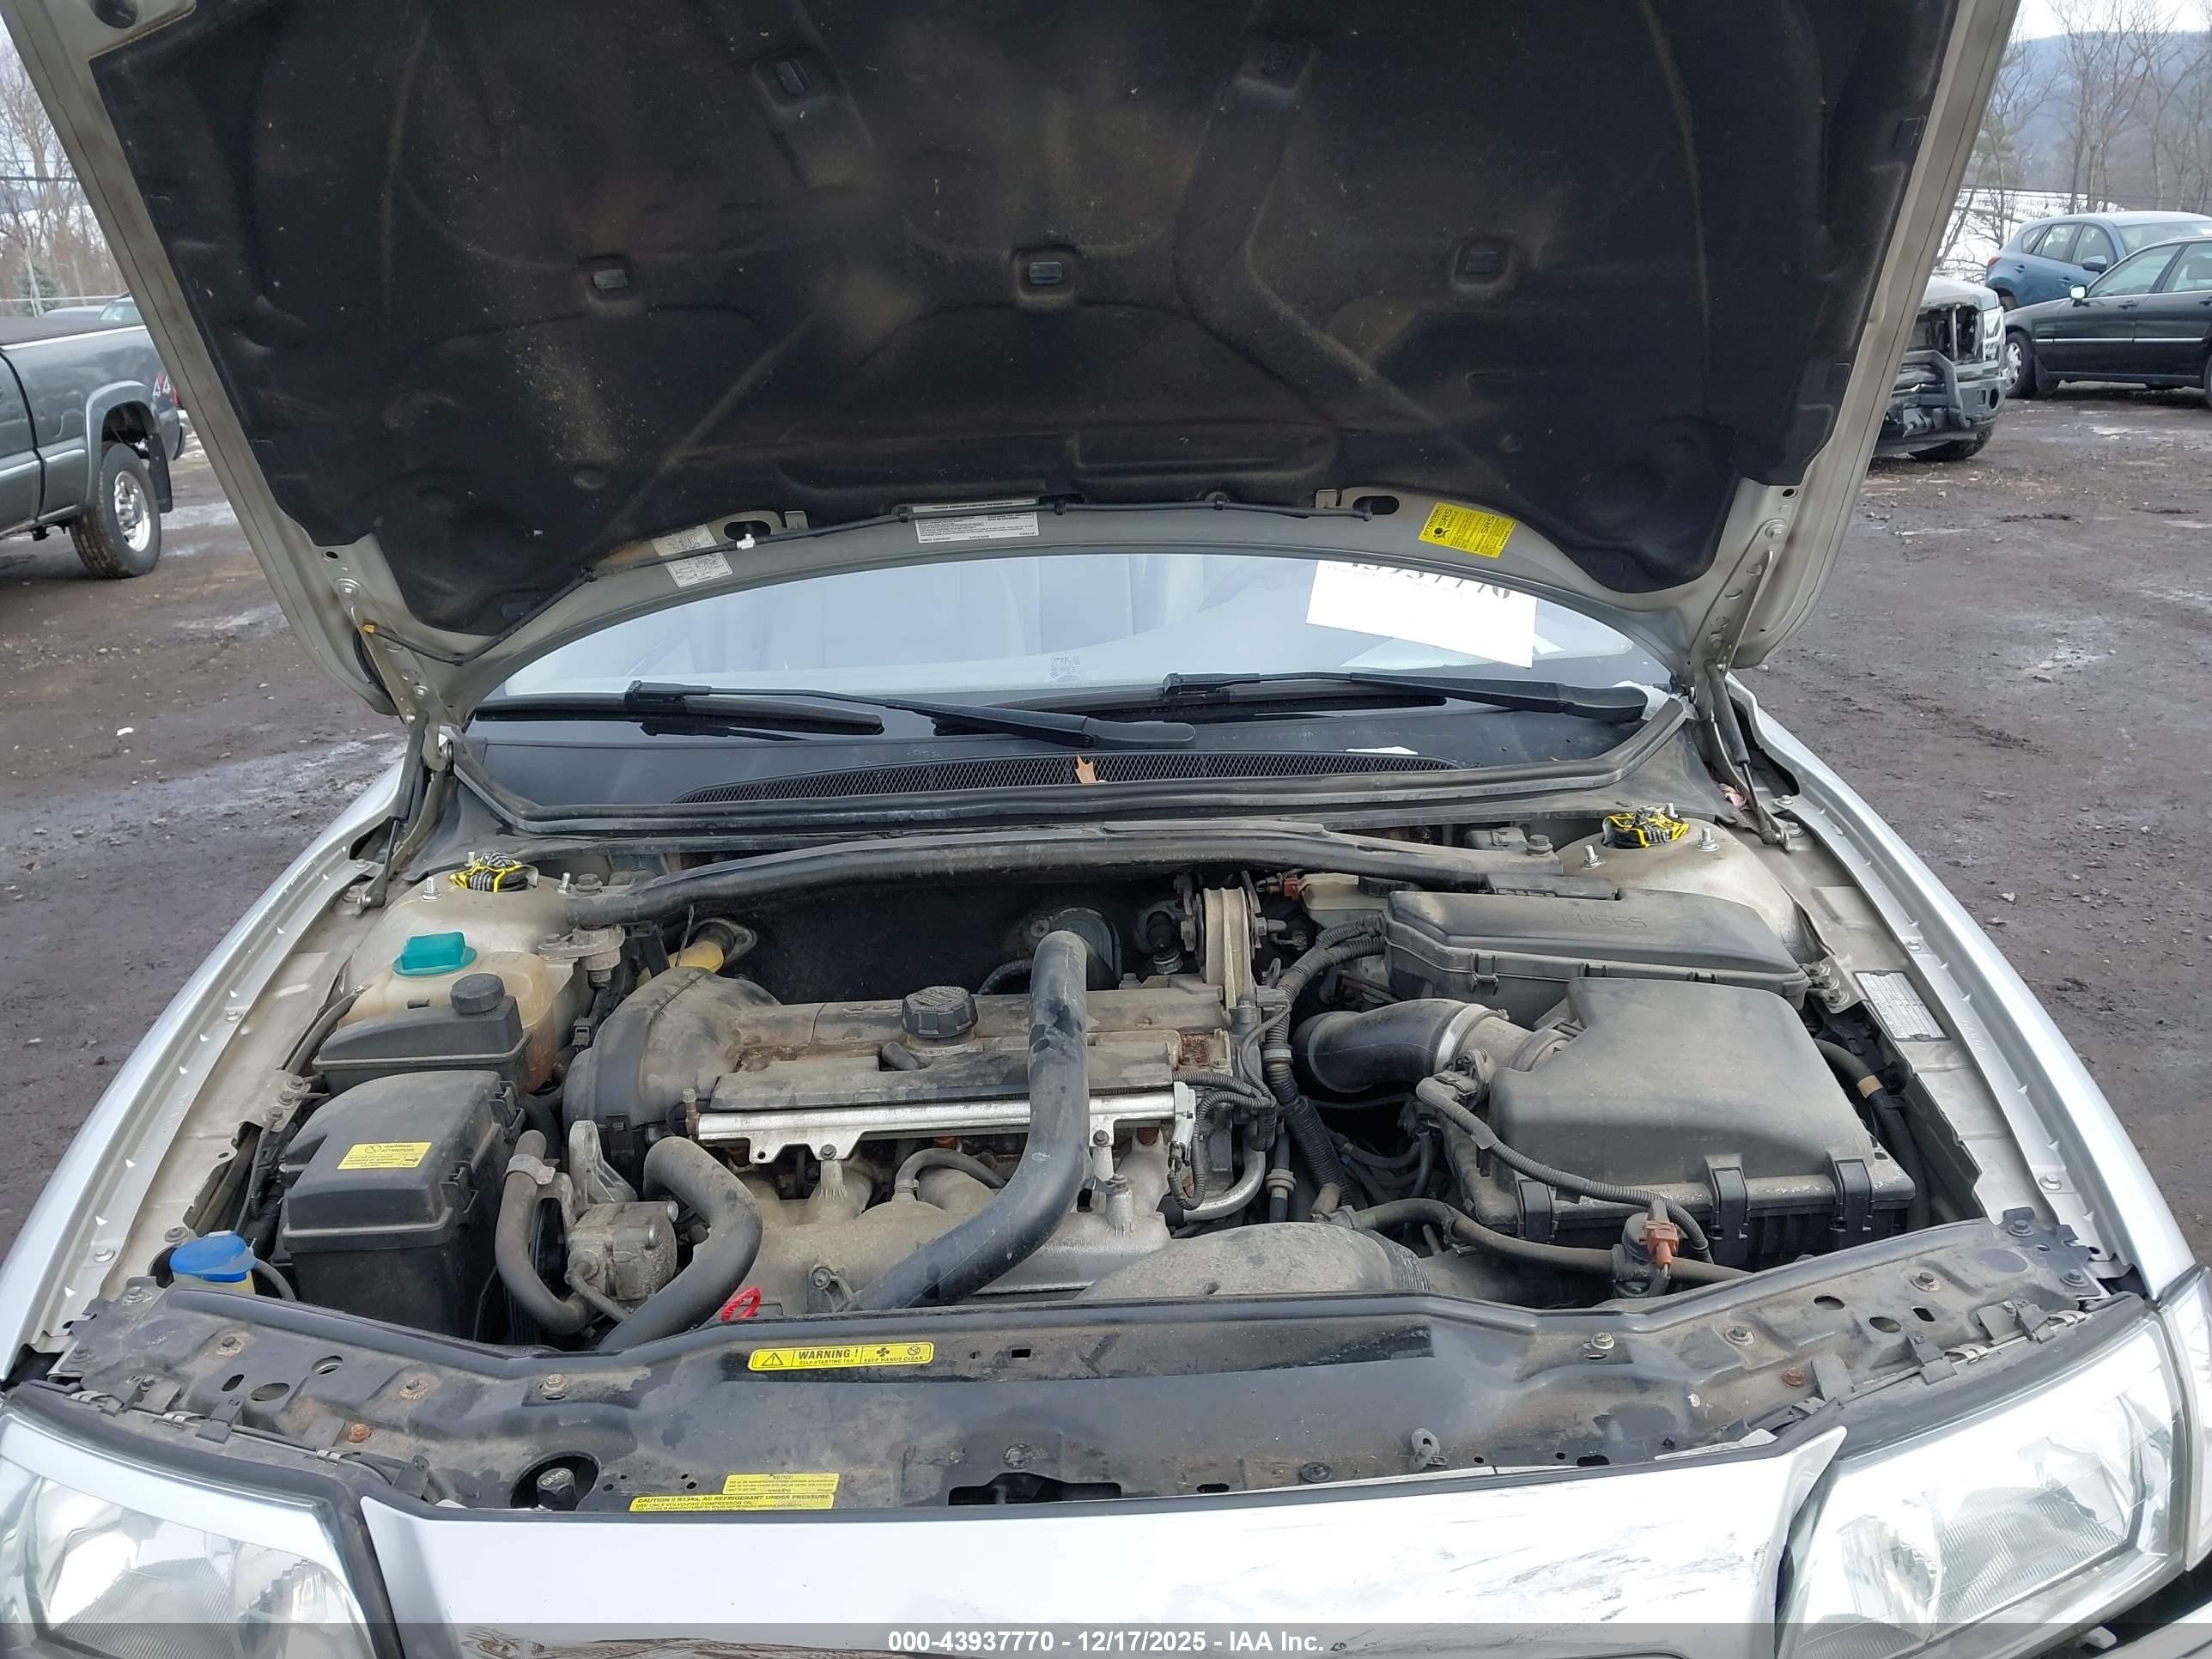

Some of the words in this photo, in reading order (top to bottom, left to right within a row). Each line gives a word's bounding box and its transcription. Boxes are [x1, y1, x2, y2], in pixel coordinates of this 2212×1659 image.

[1438, 508, 1453, 527] SRS
[1480, 515, 1495, 534] SRS
[799, 1349, 850, 1359] WARNING
